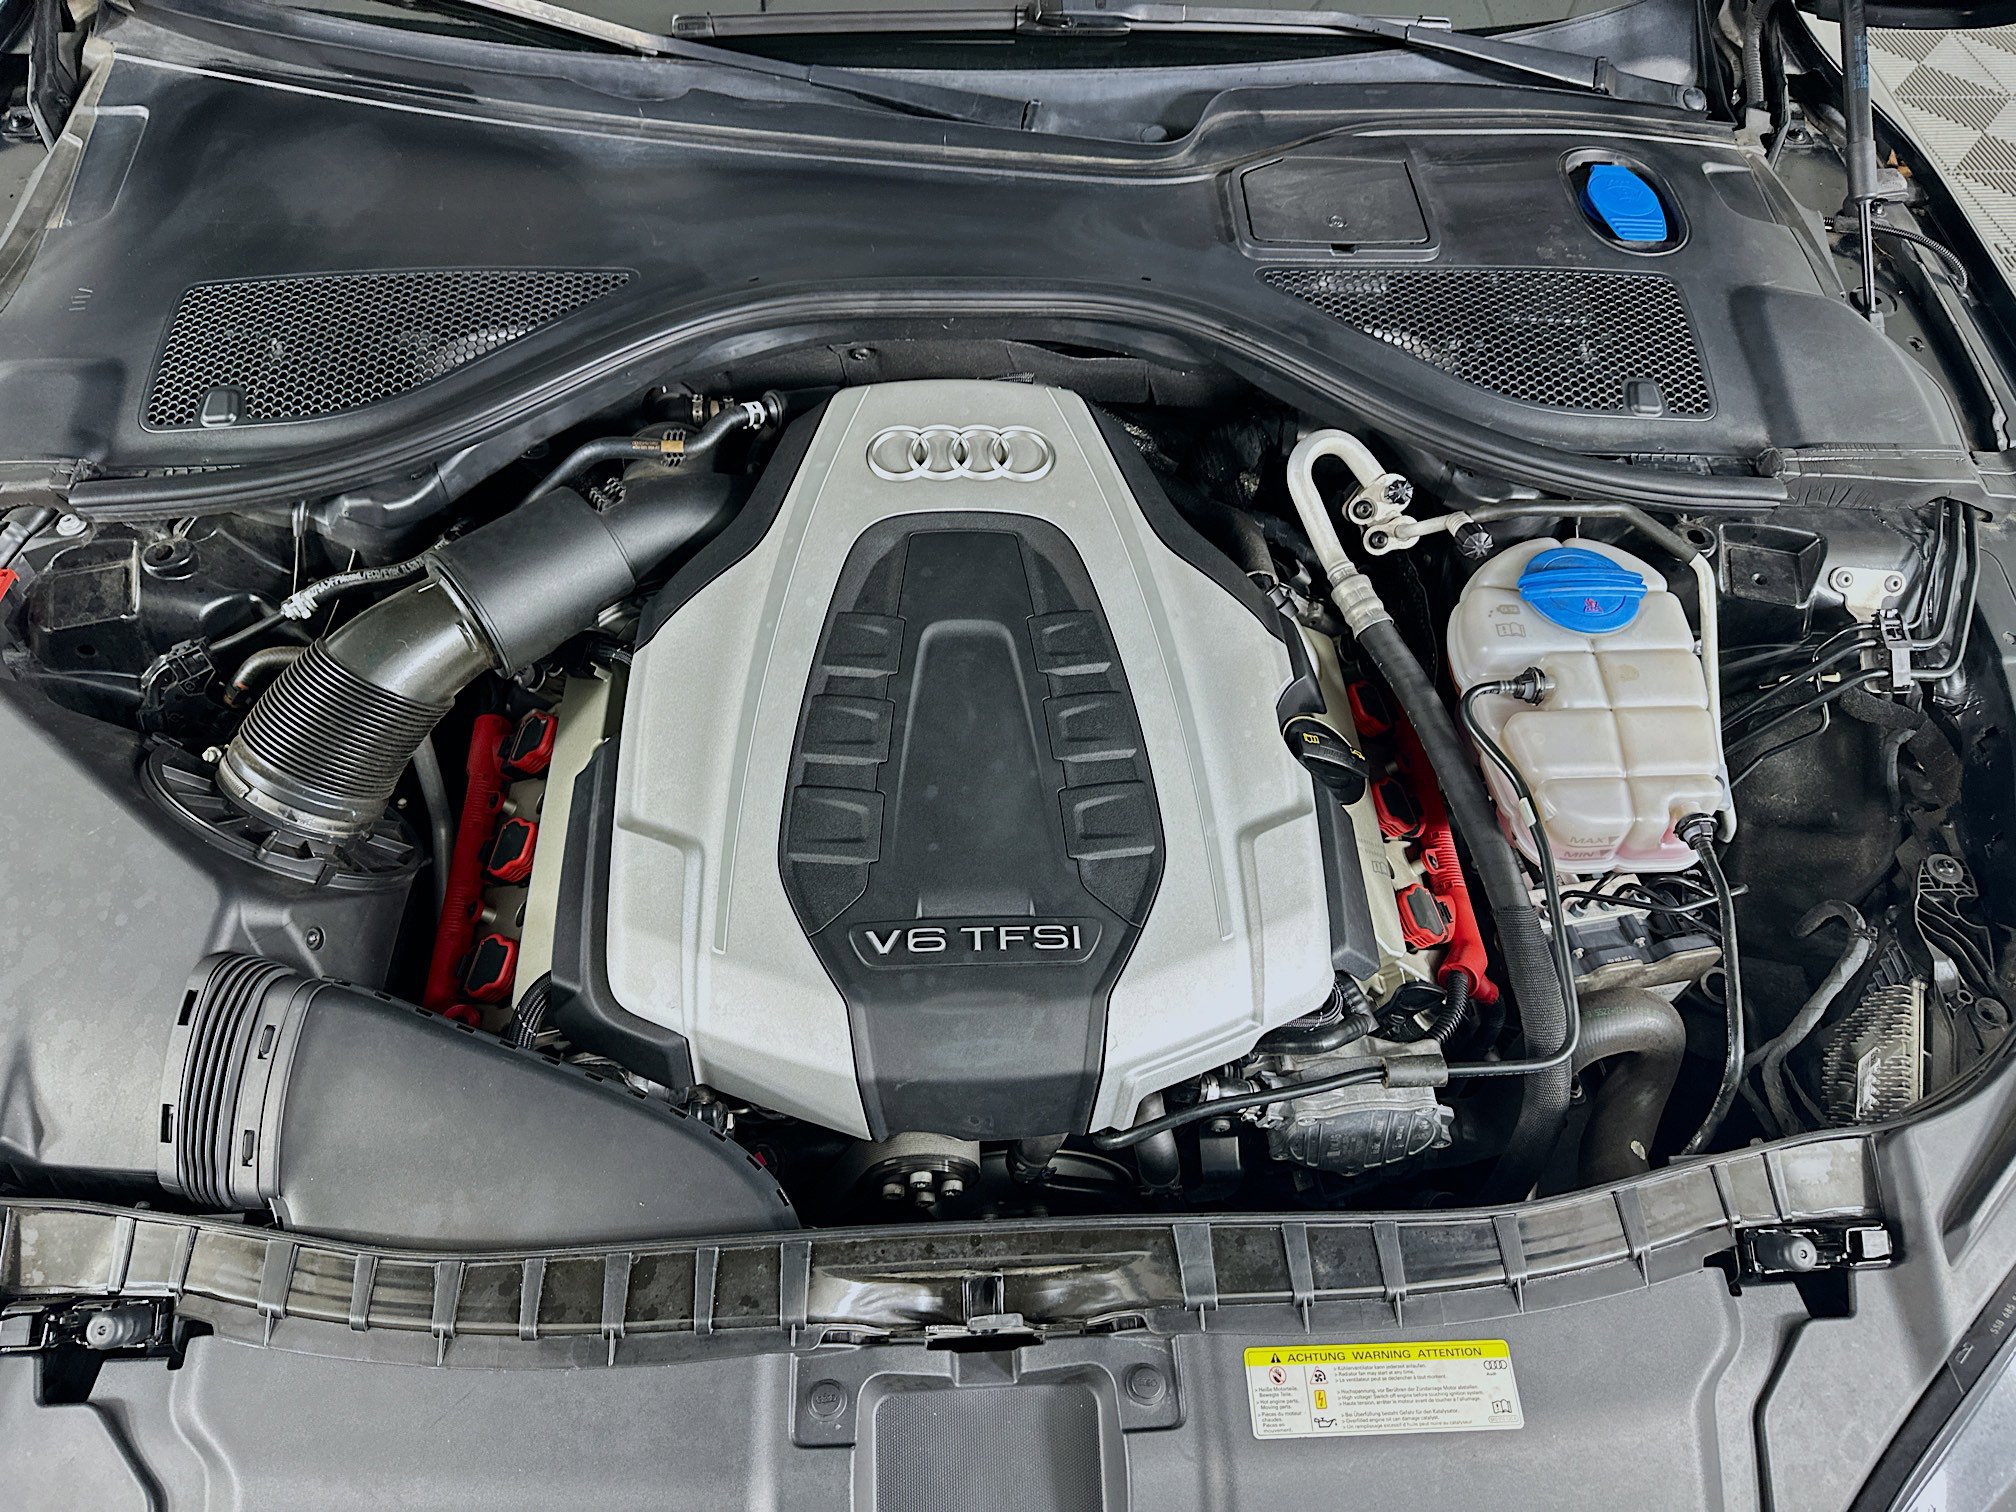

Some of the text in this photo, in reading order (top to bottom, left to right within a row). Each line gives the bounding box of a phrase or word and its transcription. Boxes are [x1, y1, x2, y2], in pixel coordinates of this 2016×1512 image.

[864, 925, 1082, 956] V6 TFSI
[1288, 1348, 1481, 1362] ACHTUNG WARNING ATTENTION
